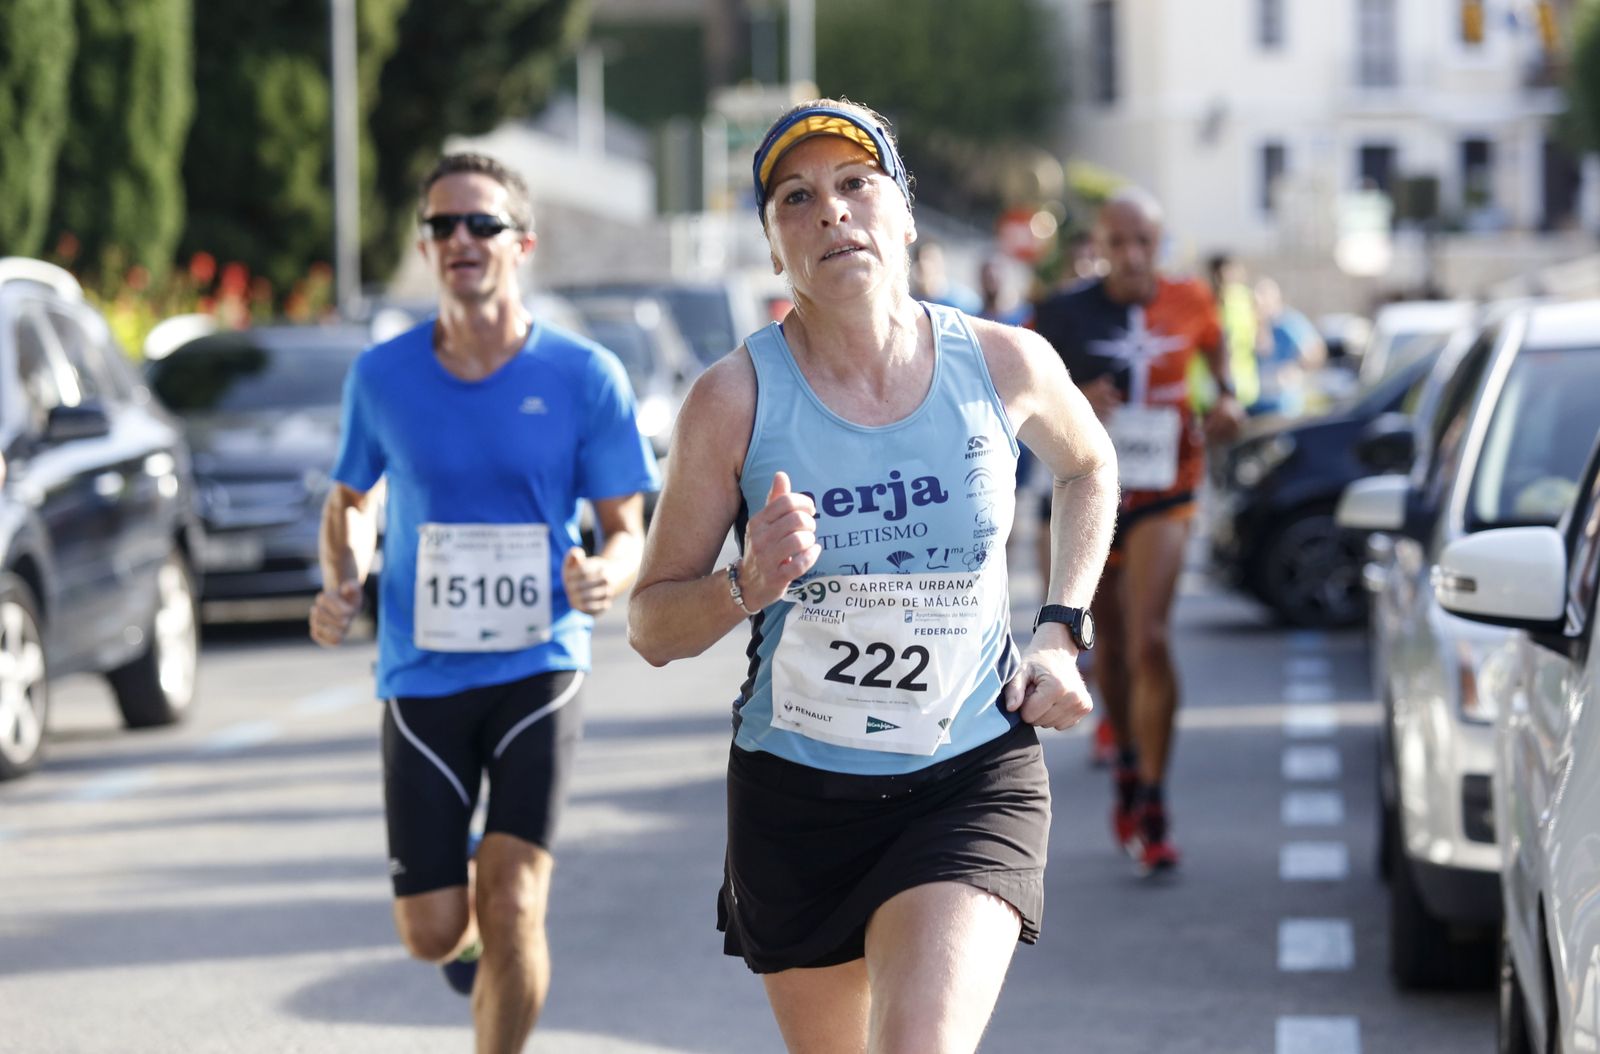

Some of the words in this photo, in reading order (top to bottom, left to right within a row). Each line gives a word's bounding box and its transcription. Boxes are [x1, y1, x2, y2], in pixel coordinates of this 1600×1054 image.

[818, 522, 928, 550] TLETISMO
[426, 575, 539, 608] 15106
[850, 581, 913, 593] CARRERA
[919, 579, 974, 591] URBANA
[845, 596, 896, 608] CIUDAD
[902, 597, 919, 608] DE
[924, 594, 979, 608] MÁLAGA
[914, 627, 968, 636] FEDERADO
[824, 640, 930, 692] 222
[795, 705, 833, 722] RENAULT
